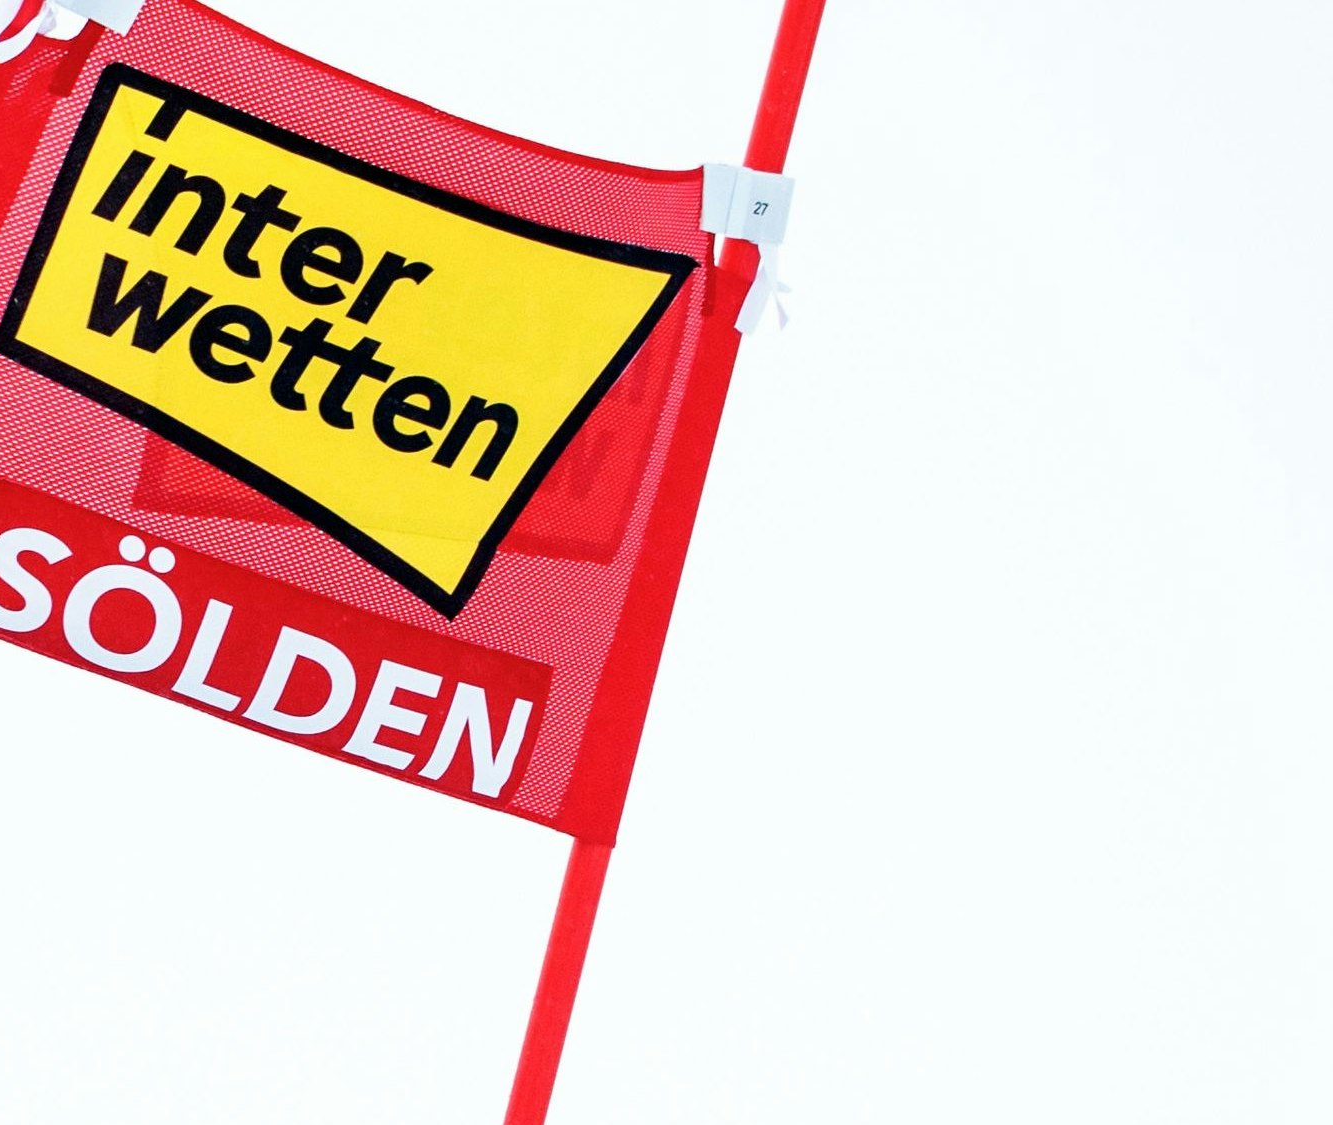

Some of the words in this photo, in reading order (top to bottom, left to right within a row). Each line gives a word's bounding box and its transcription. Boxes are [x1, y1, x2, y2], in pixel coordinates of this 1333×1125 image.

[90, 147, 433, 325] inter
[753, 201, 769, 216] 27
[87, 251, 520, 482] wetten
